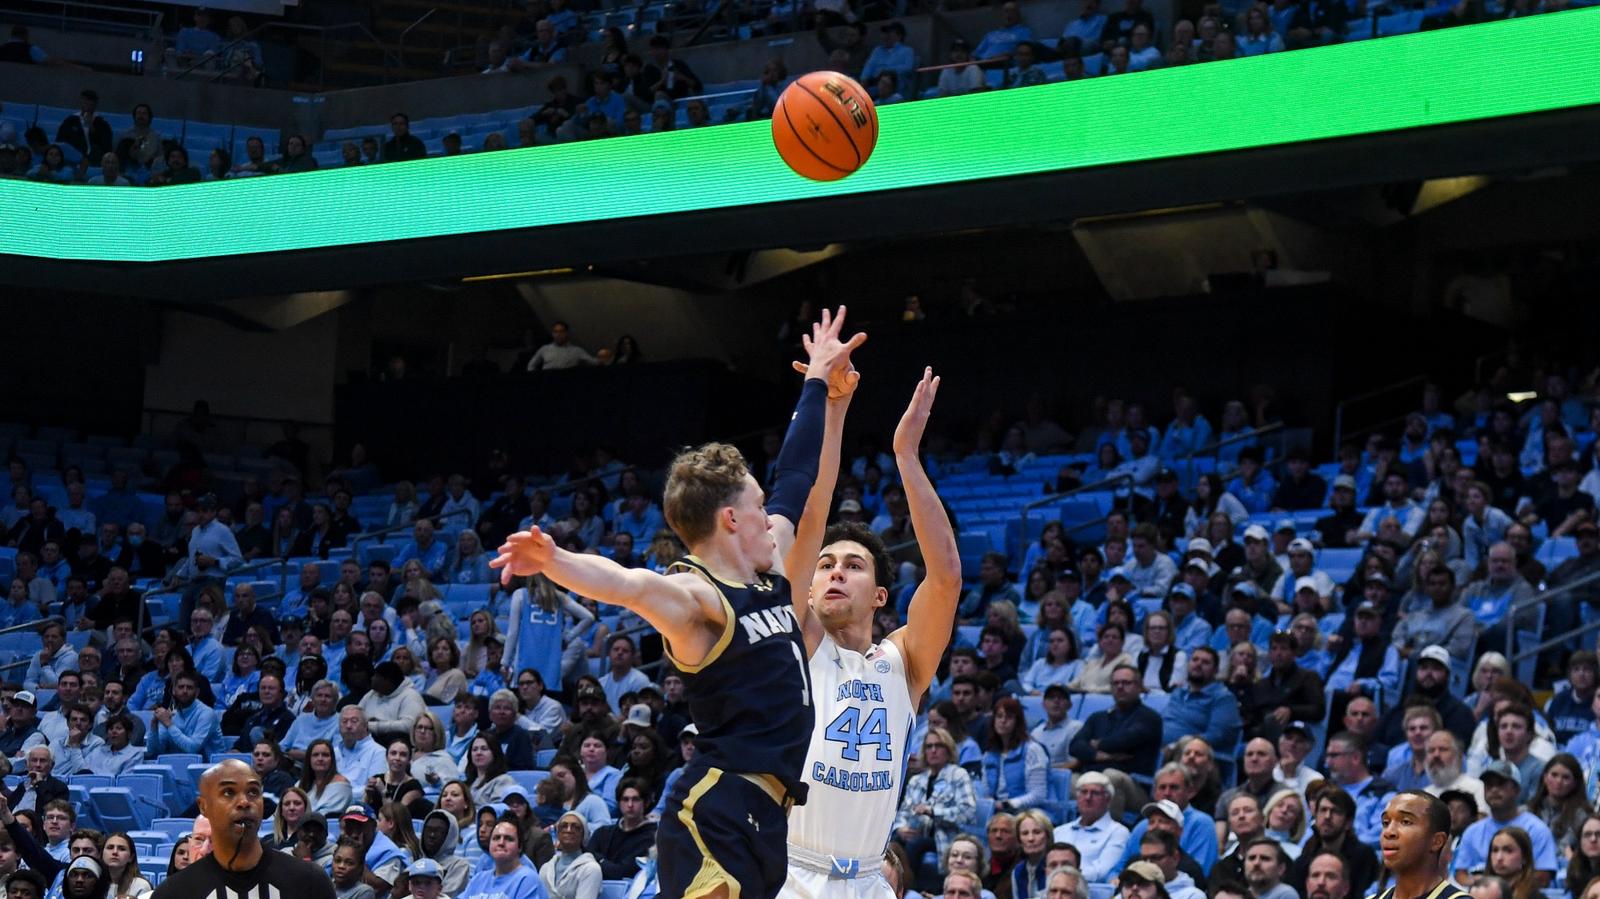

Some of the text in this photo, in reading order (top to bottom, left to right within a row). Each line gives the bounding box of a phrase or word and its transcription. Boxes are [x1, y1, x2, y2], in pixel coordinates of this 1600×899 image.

[821, 78, 867, 129] ELITE
[530, 603, 558, 625] 23
[825, 706, 892, 762] 44
[812, 761, 893, 792] CAROLIN
